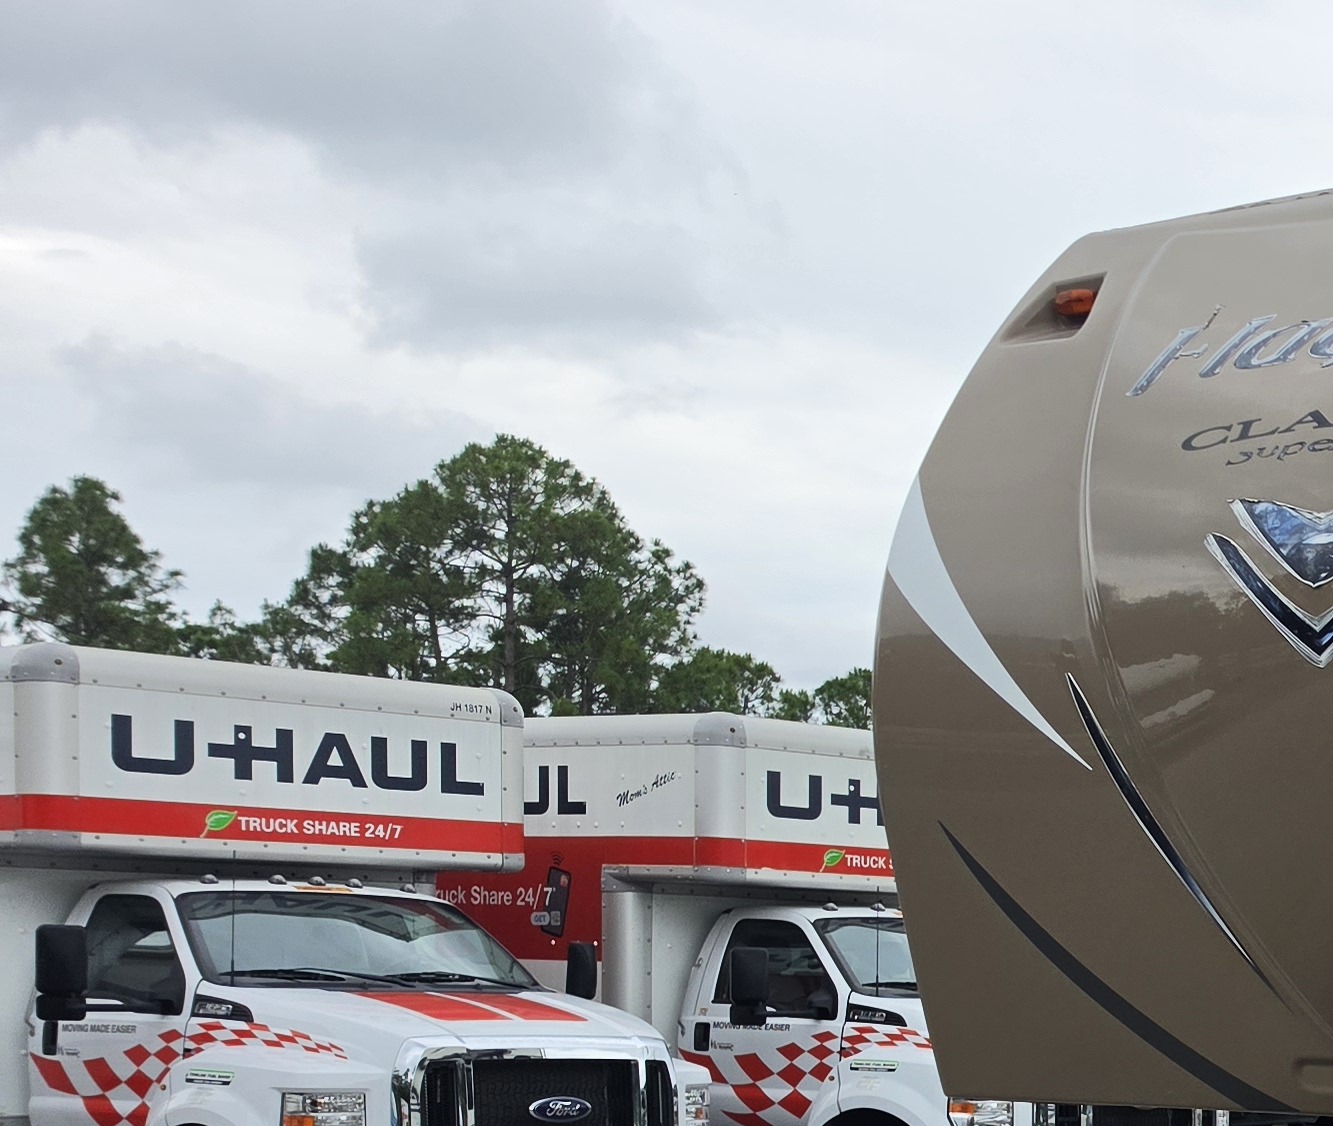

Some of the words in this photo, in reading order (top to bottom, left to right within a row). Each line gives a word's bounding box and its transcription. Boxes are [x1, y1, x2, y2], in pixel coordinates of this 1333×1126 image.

[449, 702, 462, 712] JH
[464, 703, 483, 714] 1817
[485, 705, 492, 714] N
[111, 713, 485, 796] U-HAUL
[616, 785, 648, 807] Mom's
[650, 770, 677, 793] Attic
[237, 816, 299, 834] TRUCK
[302, 820, 360, 837] SHARE
[364, 823, 403, 840] 24/7
[845, 854, 887, 869] TRUCK
[470, 885, 513, 906] Share
[516, 883, 553, 910] 24/7
[61, 1023, 89, 1033] MOVING
[89, 1024, 110, 1033] MADE
[111, 1024, 137, 1034] EASIER
[764, 1023, 790, 1031] EASIER
[546, 1100, 581, 1116] Ford
